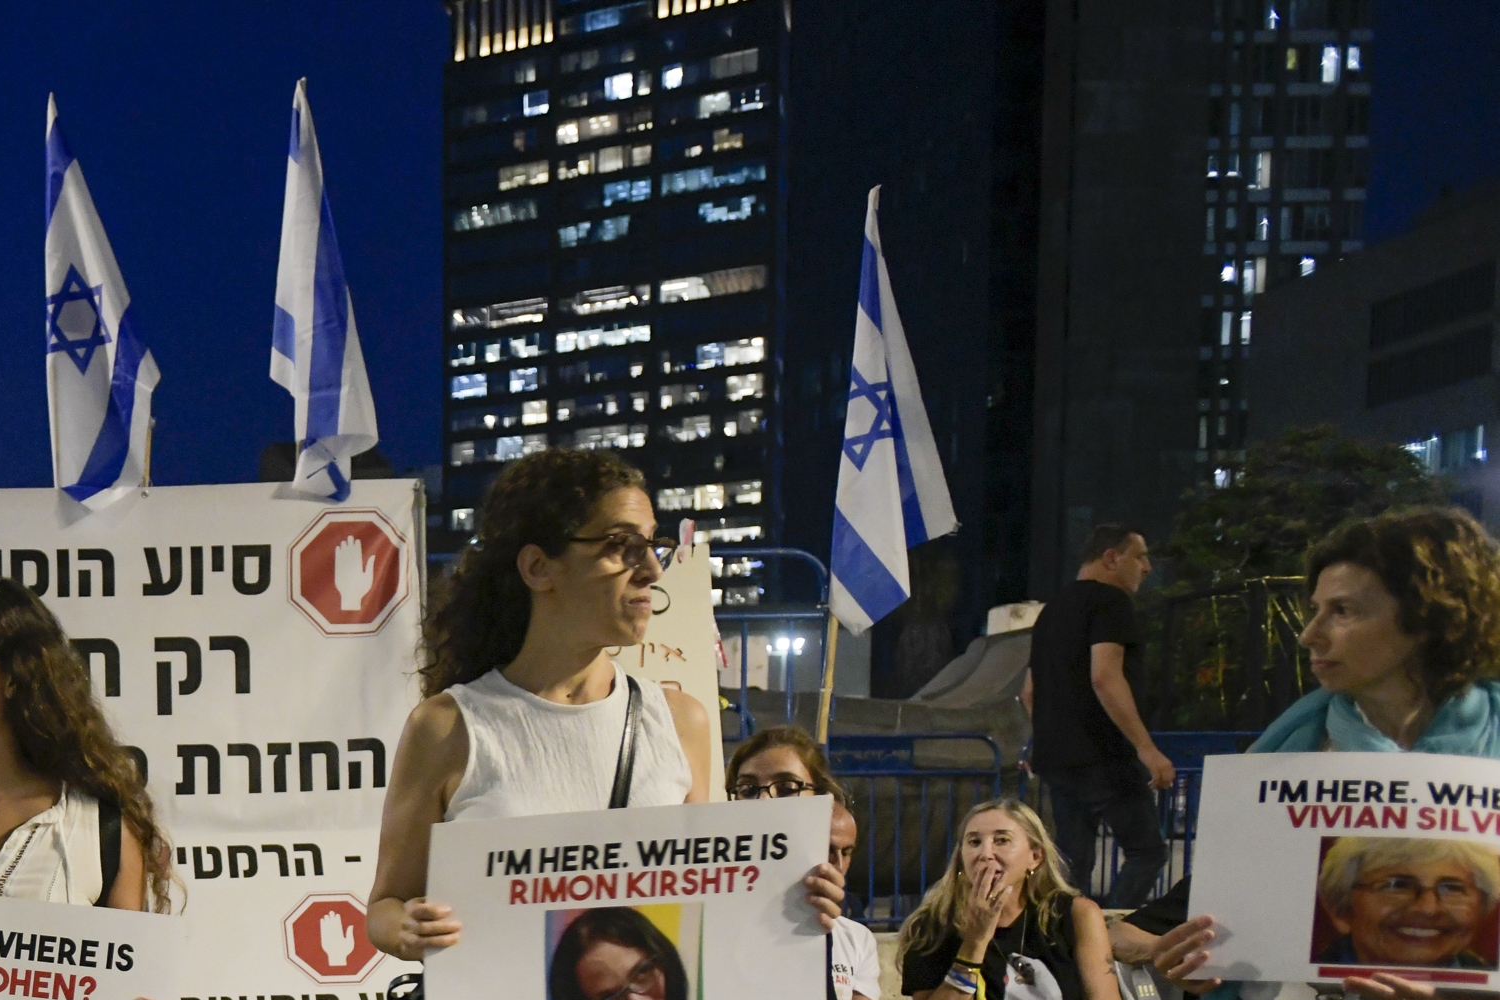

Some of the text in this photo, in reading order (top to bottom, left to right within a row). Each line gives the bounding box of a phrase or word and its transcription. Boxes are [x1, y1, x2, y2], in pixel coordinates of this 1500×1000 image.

[142, 543, 272, 597] סיוע
[154, 635, 251, 715] רק
[175, 737, 386, 796] החזרת
[1258, 780, 1308, 803] I'M
[1315, 780, 1418, 804] HERE.
[1287, 804, 1500, 835] VIVIAN SILV
[486, 832, 789, 877] I'M HERE. WHERE IS
[509, 865, 760, 906] RIMON KIRSHT?
[105, 942, 135, 971] IS
